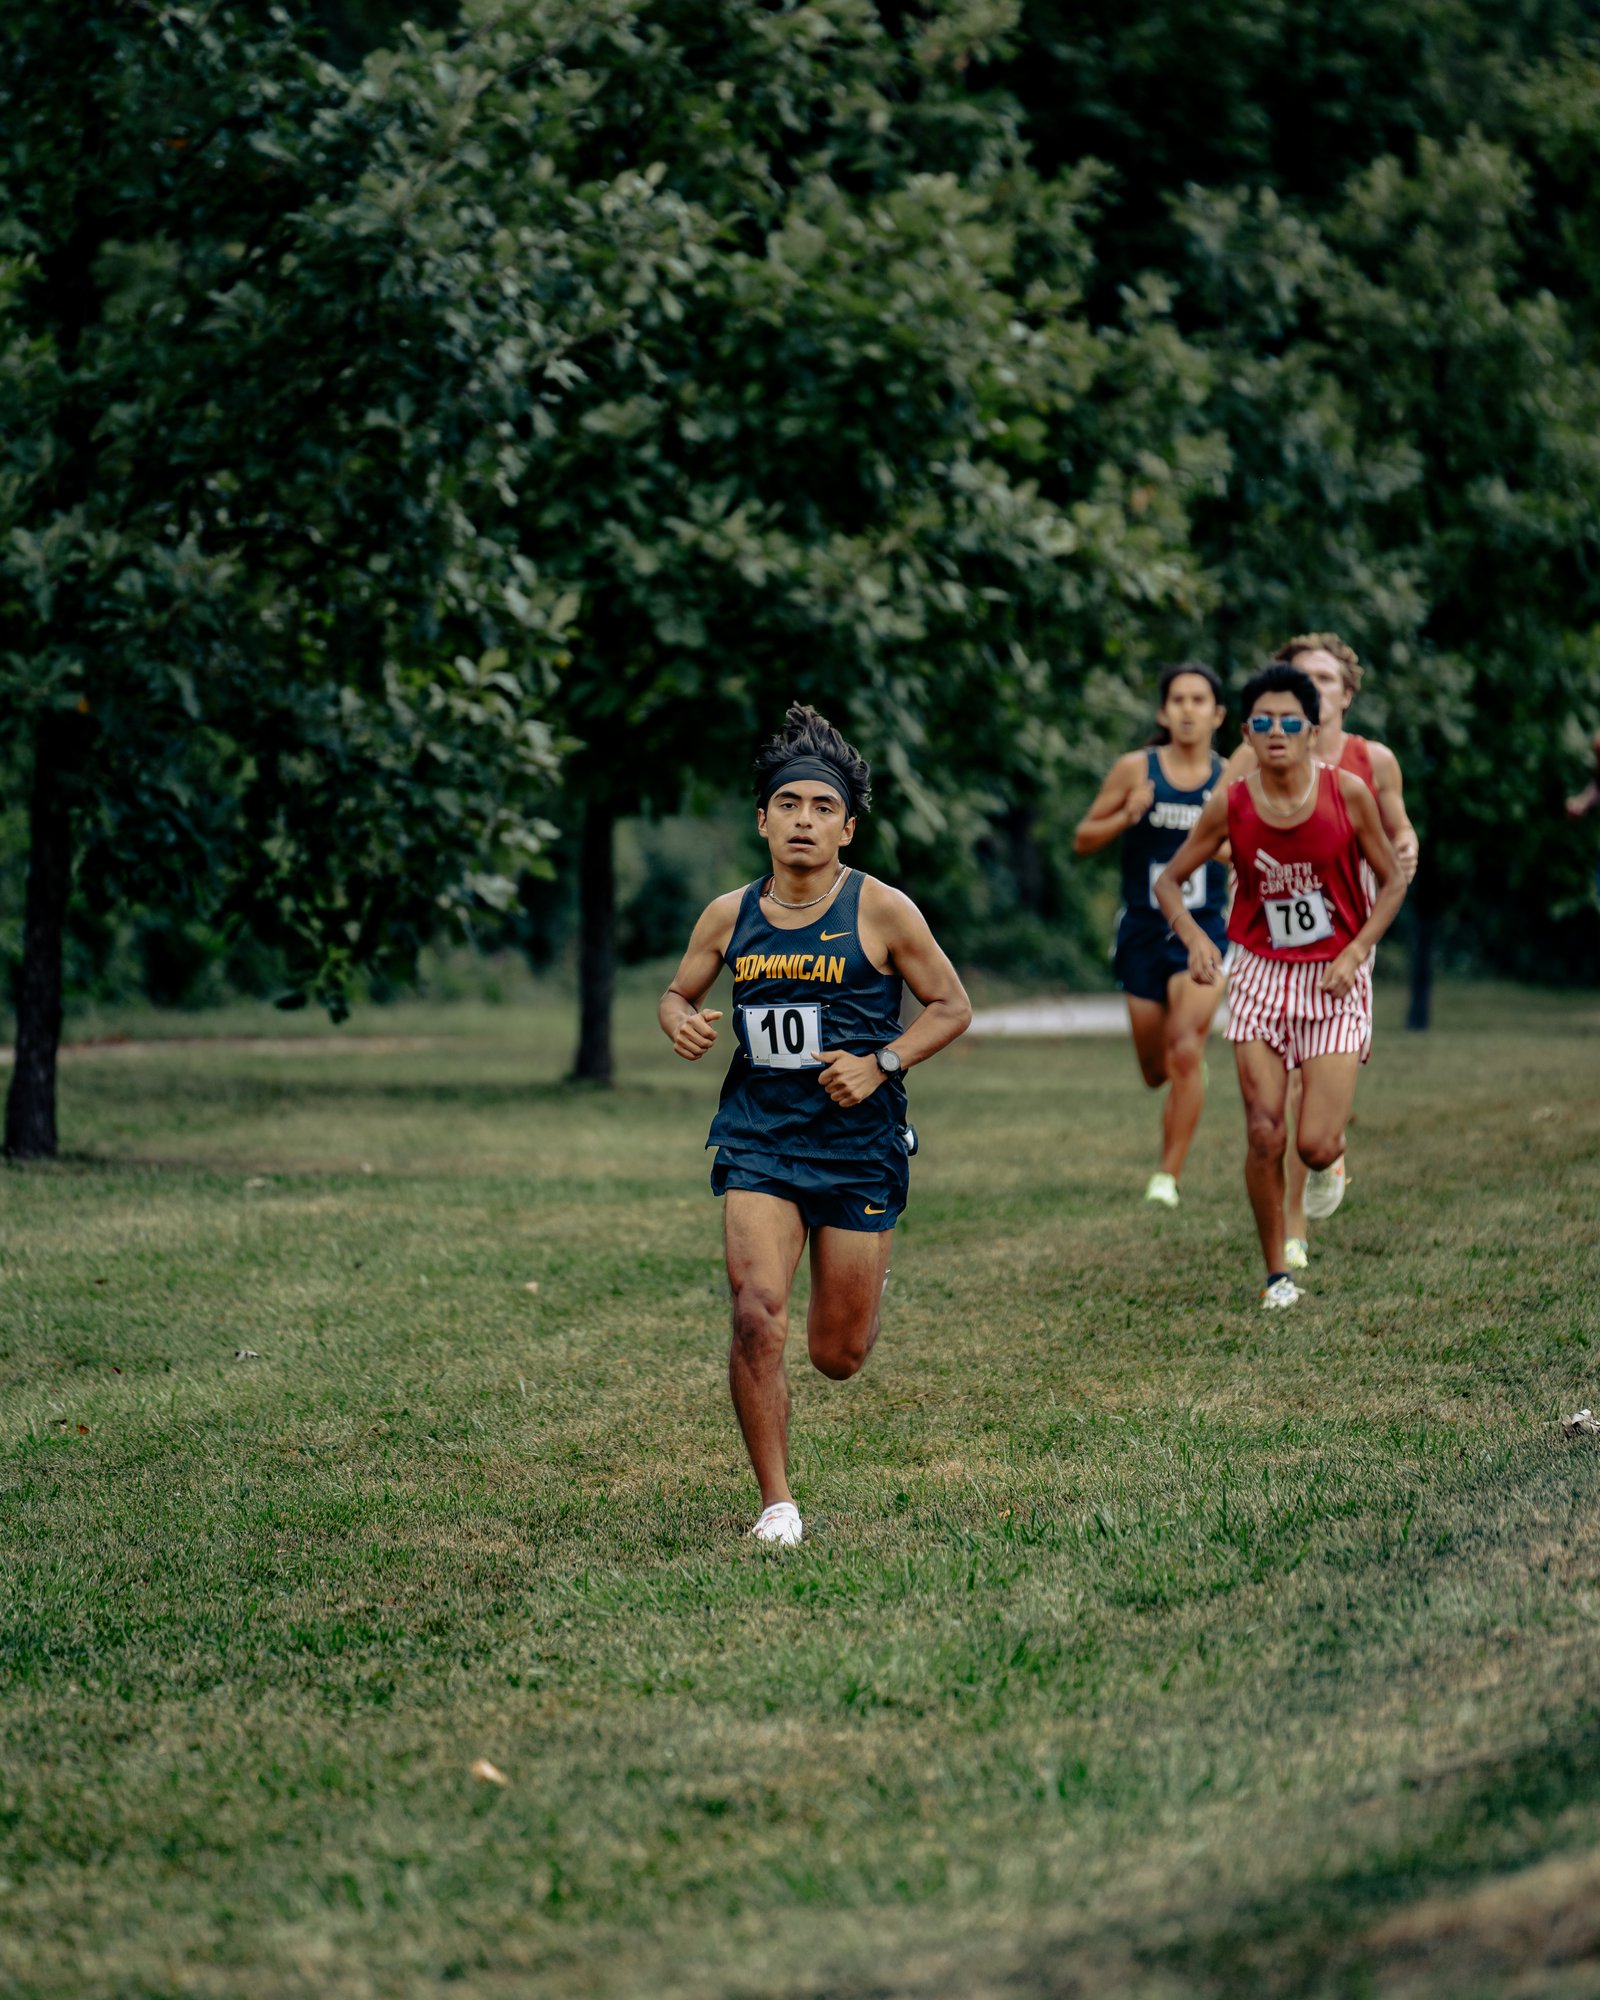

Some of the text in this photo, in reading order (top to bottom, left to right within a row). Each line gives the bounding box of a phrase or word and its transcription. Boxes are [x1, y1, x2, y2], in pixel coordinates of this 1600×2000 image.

[1260, 875, 1323, 895] CENTRAL
[1267, 862, 1312, 879] NORTH
[1276, 900, 1315, 935] 78
[735, 954, 846, 984] DOMINICAN
[761, 1009, 805, 1055] 10
